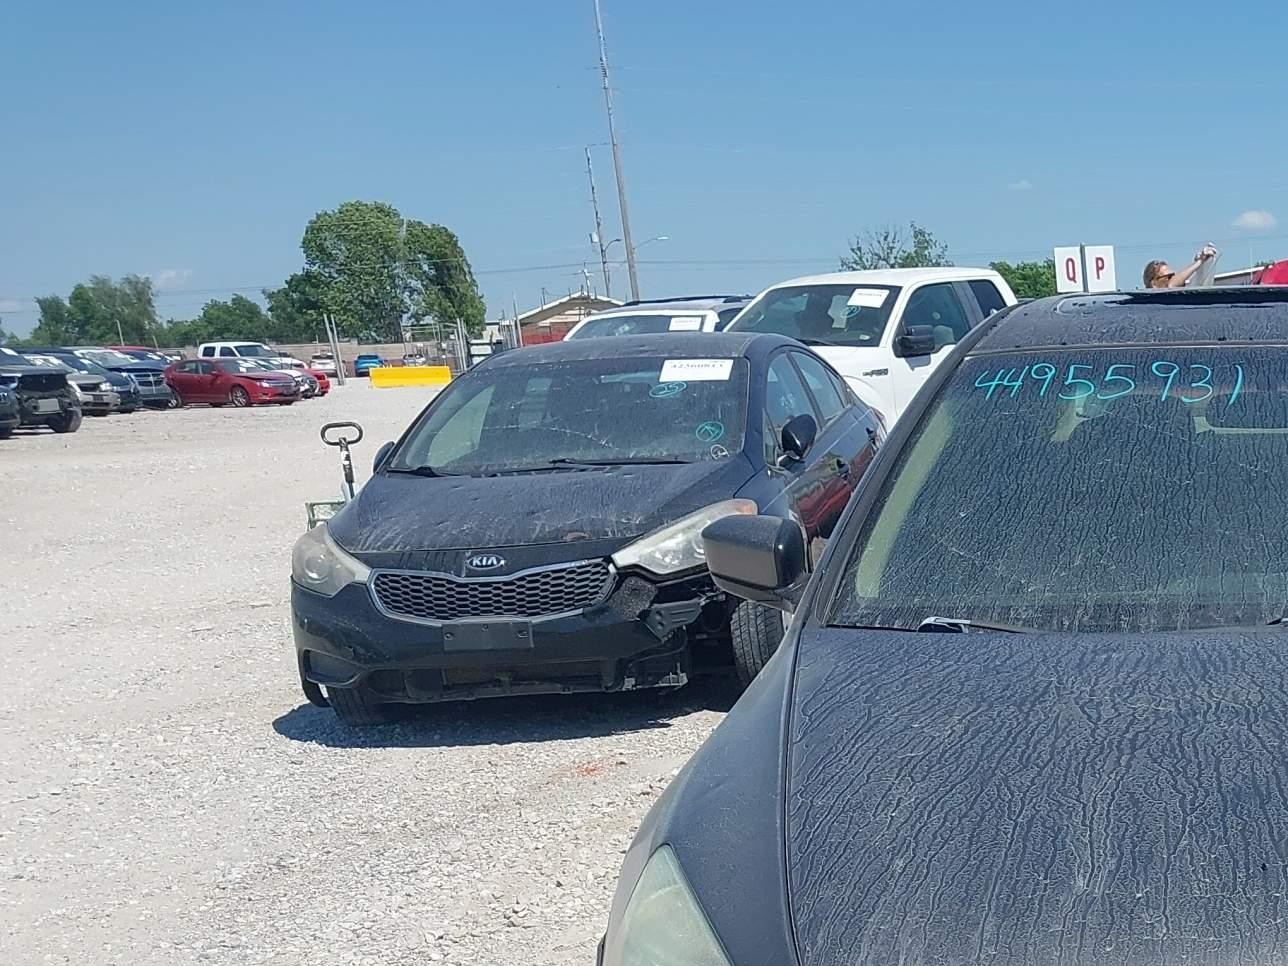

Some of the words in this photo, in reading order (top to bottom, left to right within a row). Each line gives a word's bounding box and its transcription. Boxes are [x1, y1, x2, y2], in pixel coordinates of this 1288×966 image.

[1065, 257, 1077, 283] Q
[1095, 256, 1105, 280] P
[975, 362, 1243, 405] 44955931
[472, 556, 498, 566] KIA
